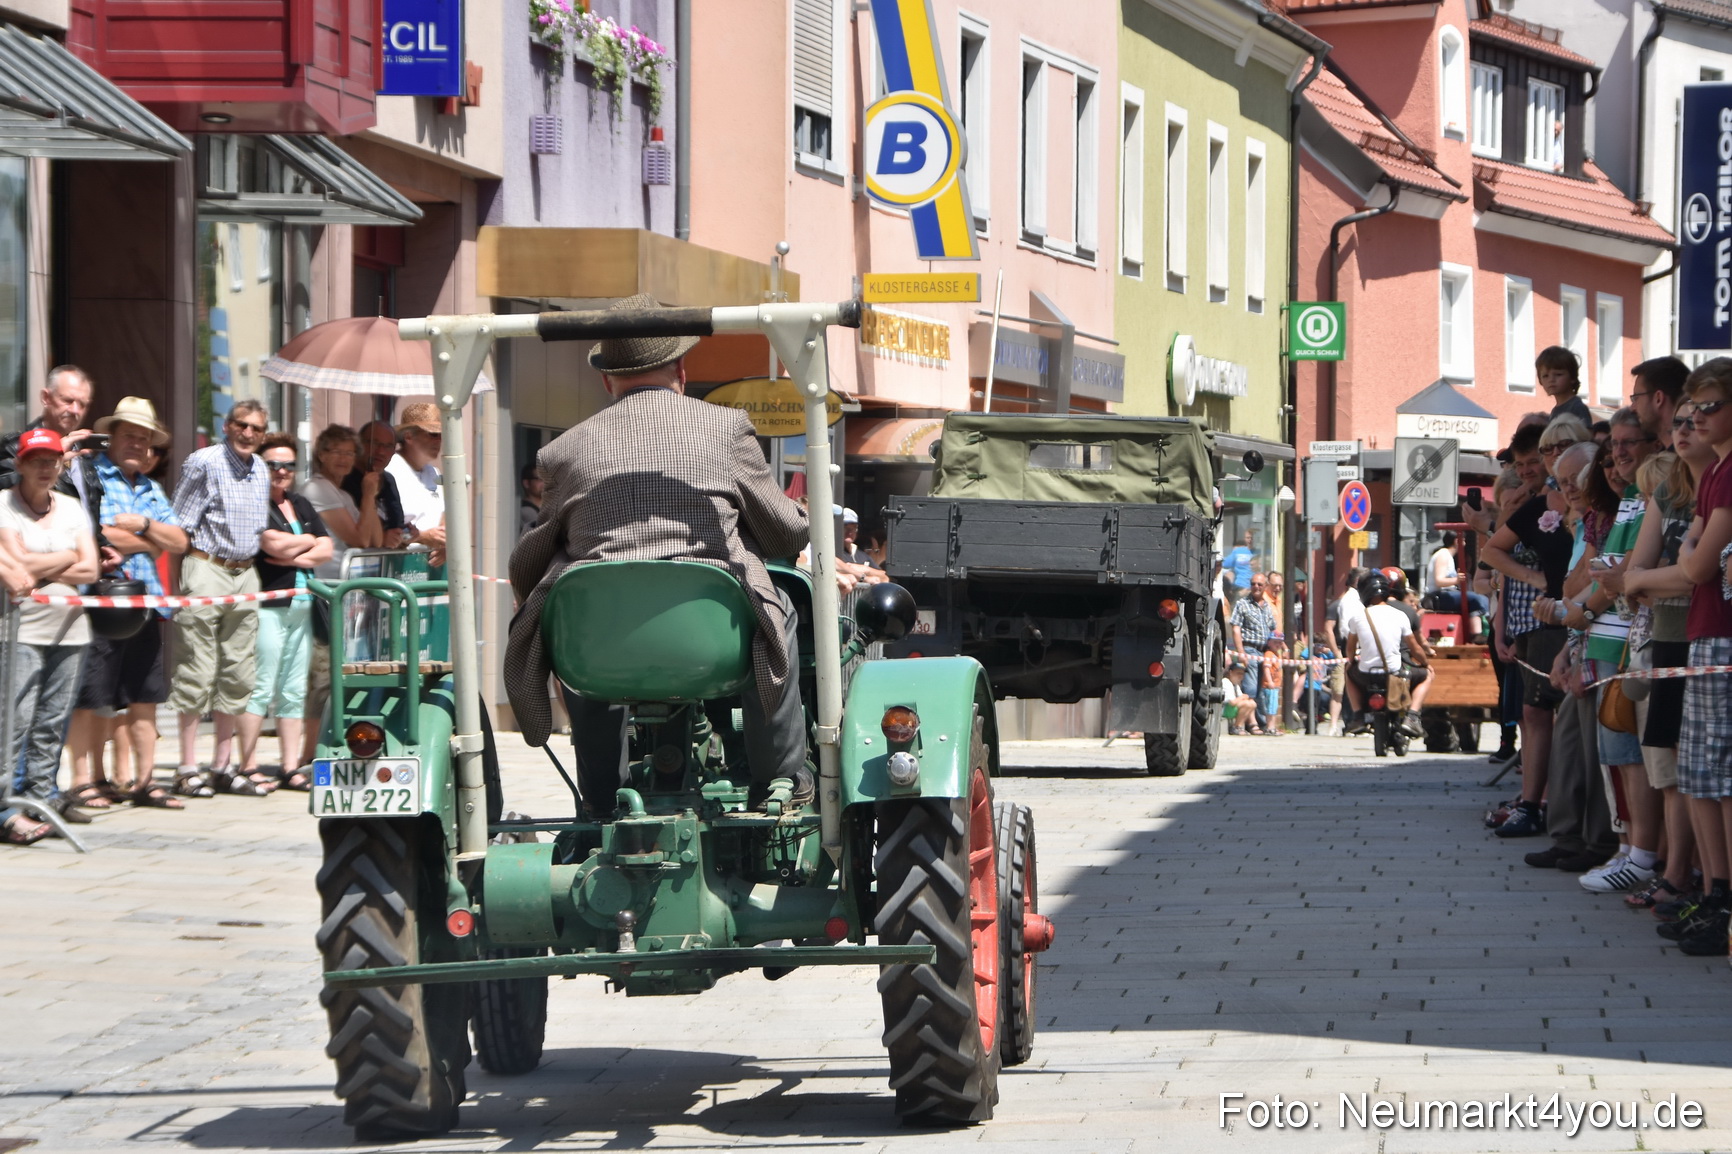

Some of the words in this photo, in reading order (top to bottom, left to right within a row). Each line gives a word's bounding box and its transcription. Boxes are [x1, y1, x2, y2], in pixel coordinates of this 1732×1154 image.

[876, 121, 928, 174] B
[1718, 107, 1732, 231] TAILOR
[869, 281, 959, 293] KLOSTERGASSE
[964, 281, 971, 292] 4
[1714, 238, 1731, 327] TOM
[734, 402, 840, 413] GOLDSCHMDE
[769, 418, 801, 426] ROTHER
[1417, 416, 1480, 438] Creppresso
[1312, 444, 1352, 453] Klostergasse
[334, 763, 366, 785] NM
[322, 790, 354, 813] AW
[364, 789, 411, 812] 272
